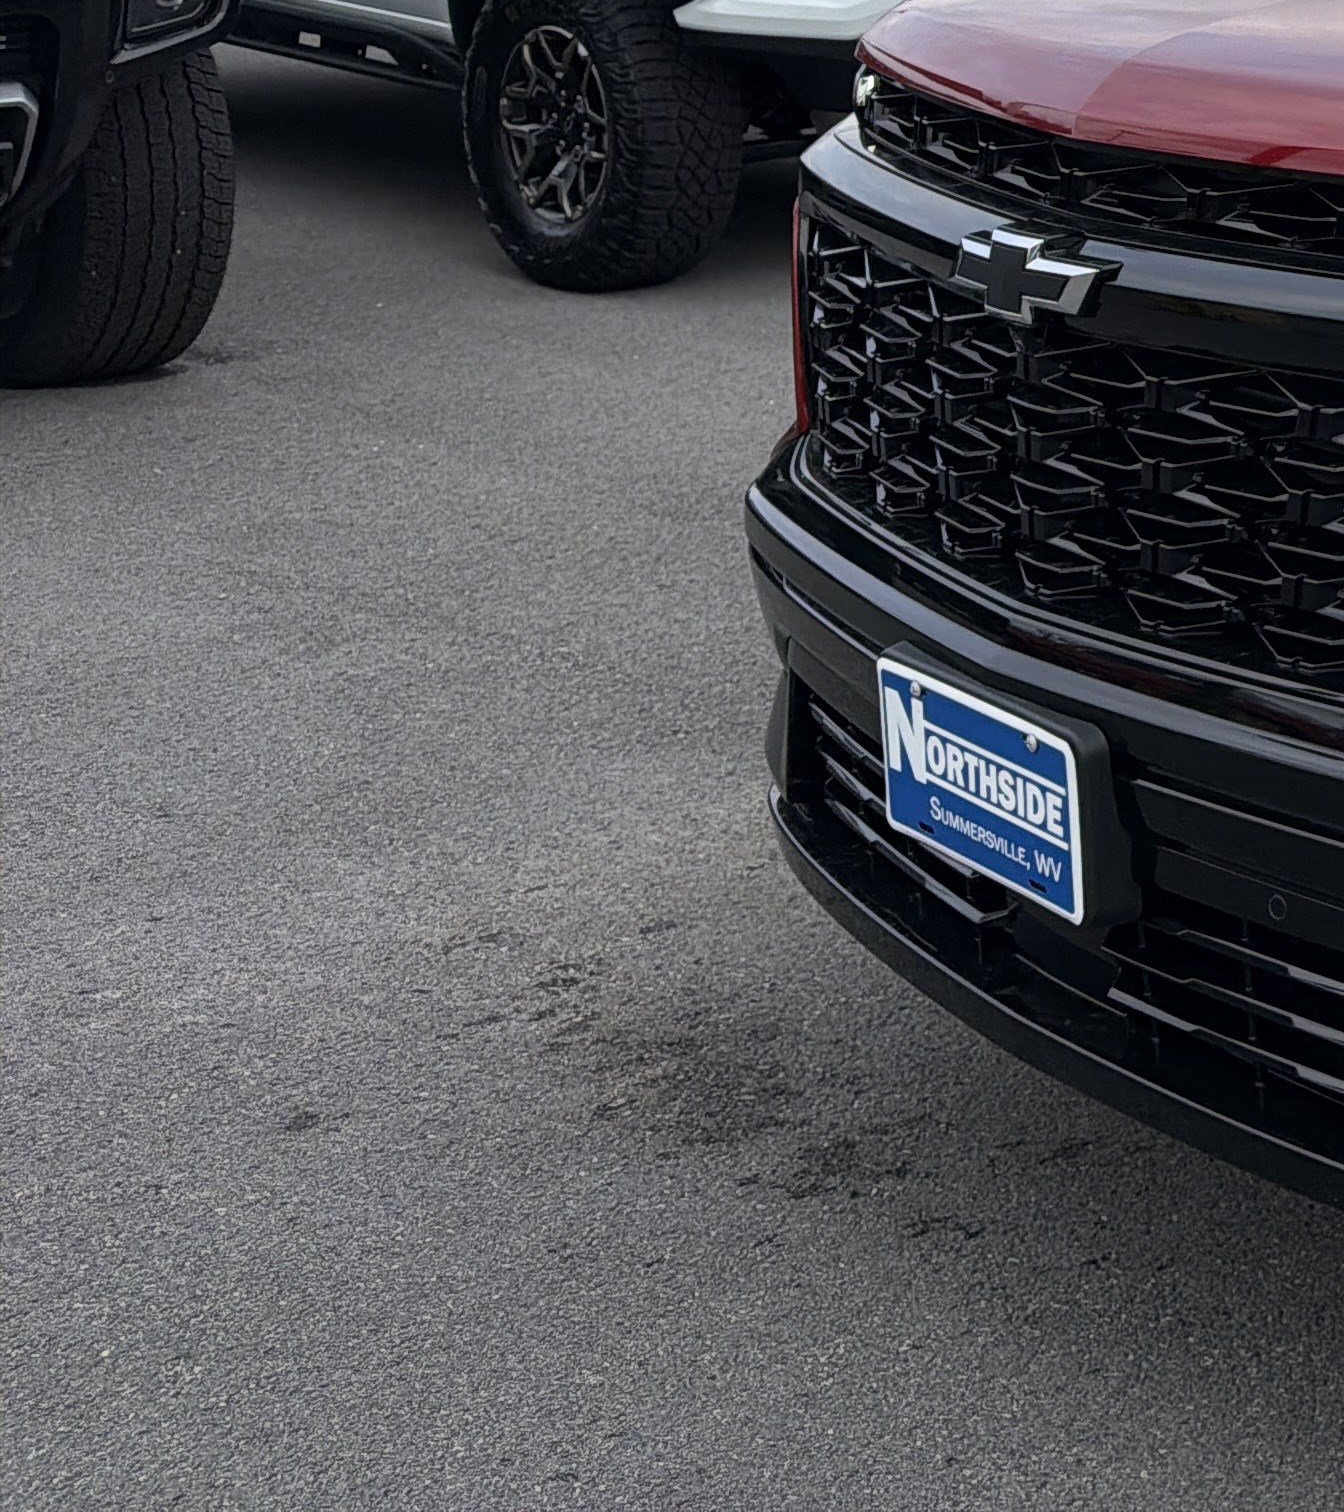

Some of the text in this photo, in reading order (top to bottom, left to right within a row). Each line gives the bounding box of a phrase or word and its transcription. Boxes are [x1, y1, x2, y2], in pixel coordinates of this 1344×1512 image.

[884, 686, 1064, 838] NORTHSIDE
[929, 795, 1063, 882] SUMMERSVILLE, WV
